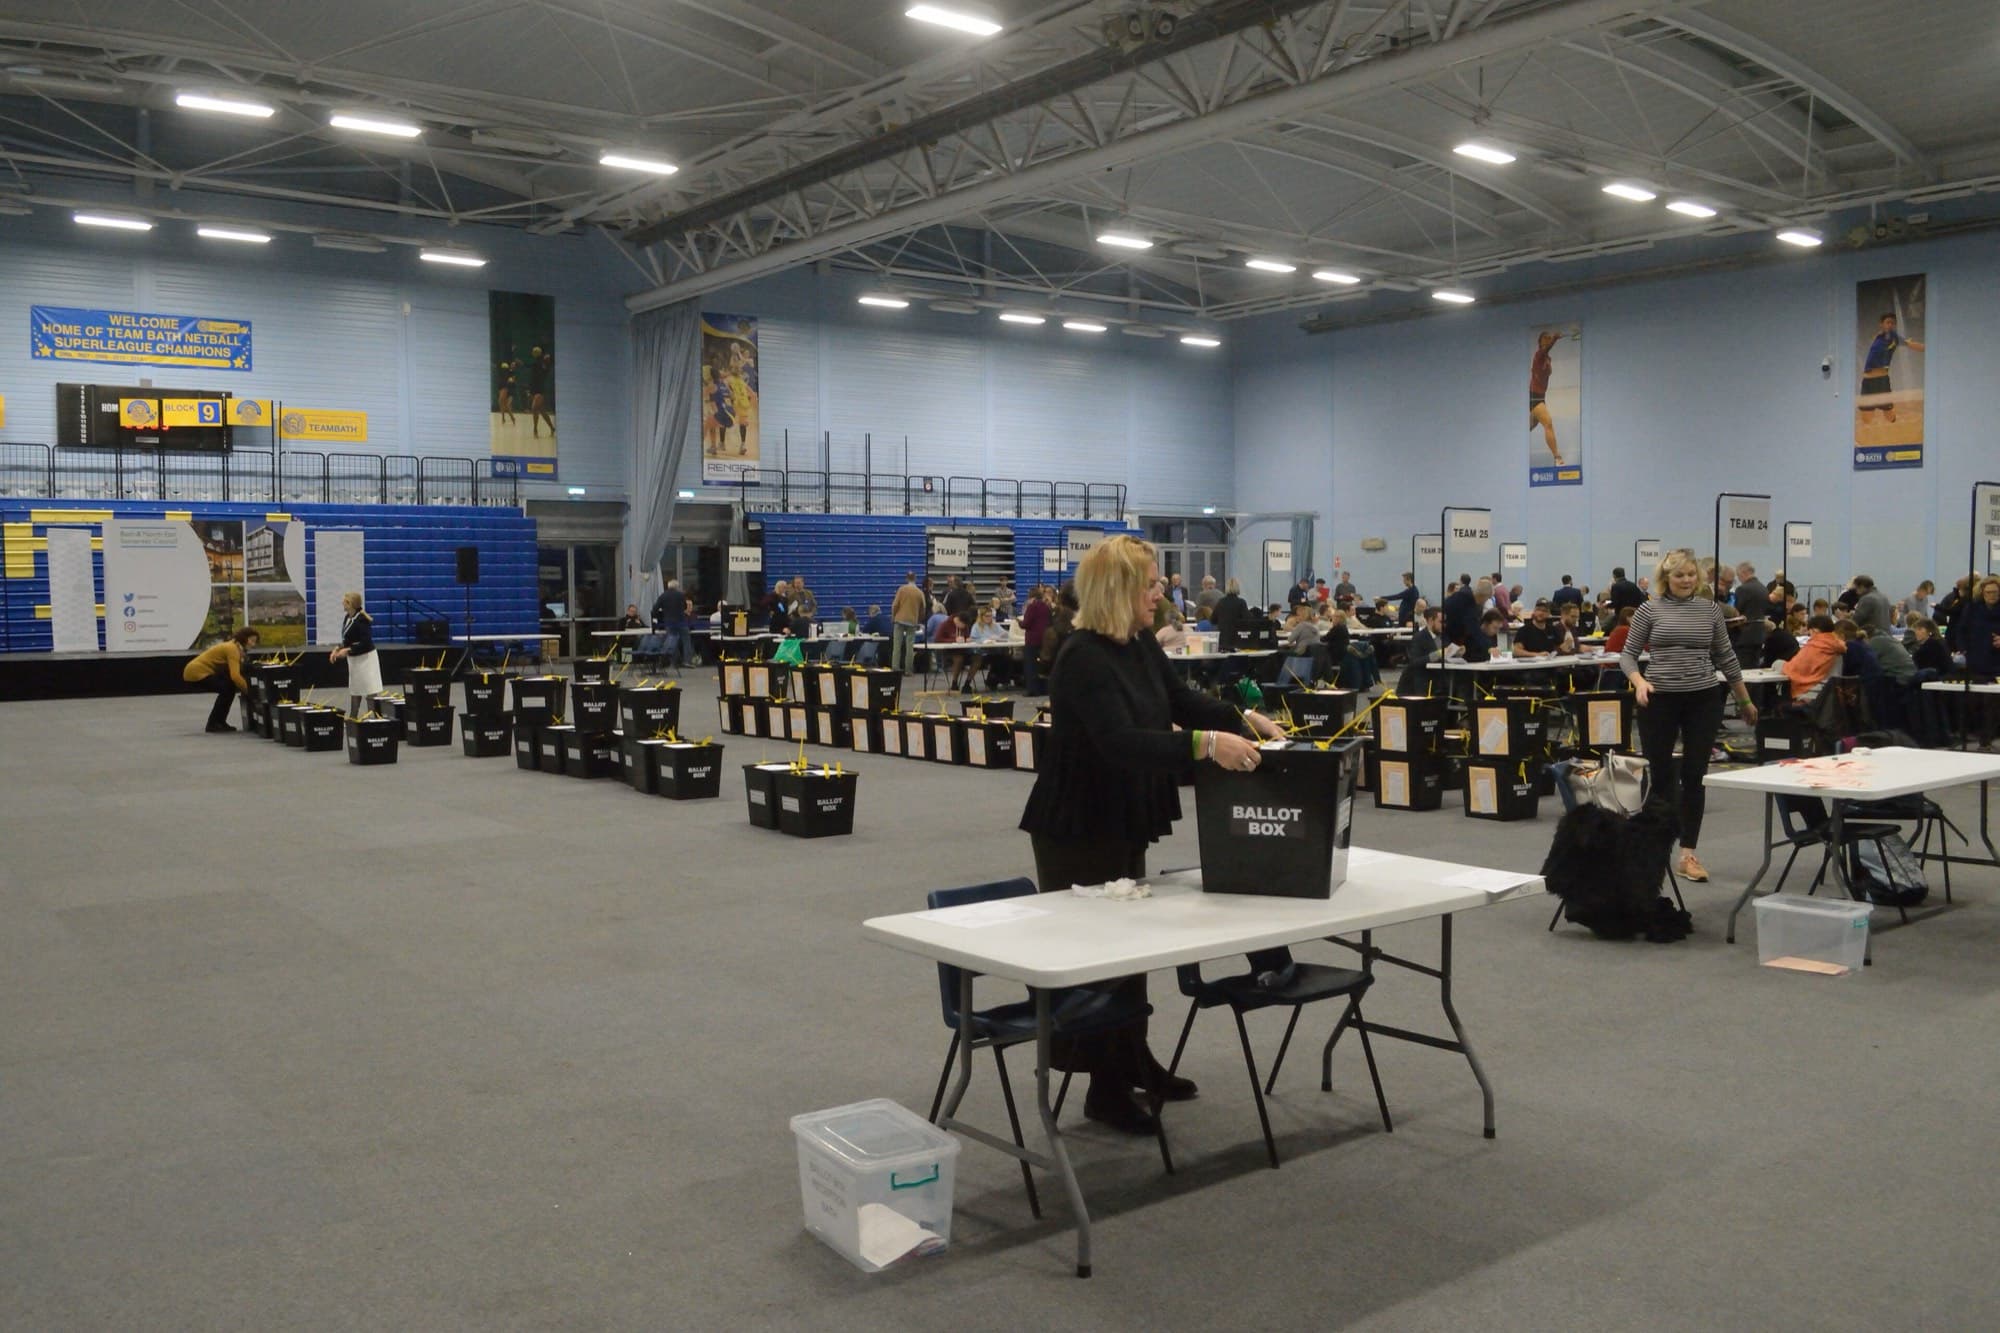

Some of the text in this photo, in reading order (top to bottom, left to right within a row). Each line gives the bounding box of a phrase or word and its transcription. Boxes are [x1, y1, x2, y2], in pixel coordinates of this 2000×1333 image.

[109, 315, 179, 330] WELCOME
[42, 324, 241, 346] HOME OF TEAM BATH NETBALL
[54, 337, 152, 353] SUPERLEAGUE
[156, 342, 231, 358] CHAMPIONS
[164, 404, 195, 412] BLOCK
[202, 404, 215, 421] 9
[308, 423, 358, 433] TEAMBATH
[1730, 518, 1768, 530] TEAM 24
[1453, 528, 1476, 538] TEAM
[936, 548, 956, 556] TEAM
[1070, 542, 1091, 550] TEAM
[817, 797, 843, 806] BALLOT
[1232, 805, 1302, 822] BALLOT
[1248, 822, 1286, 837] BOX
